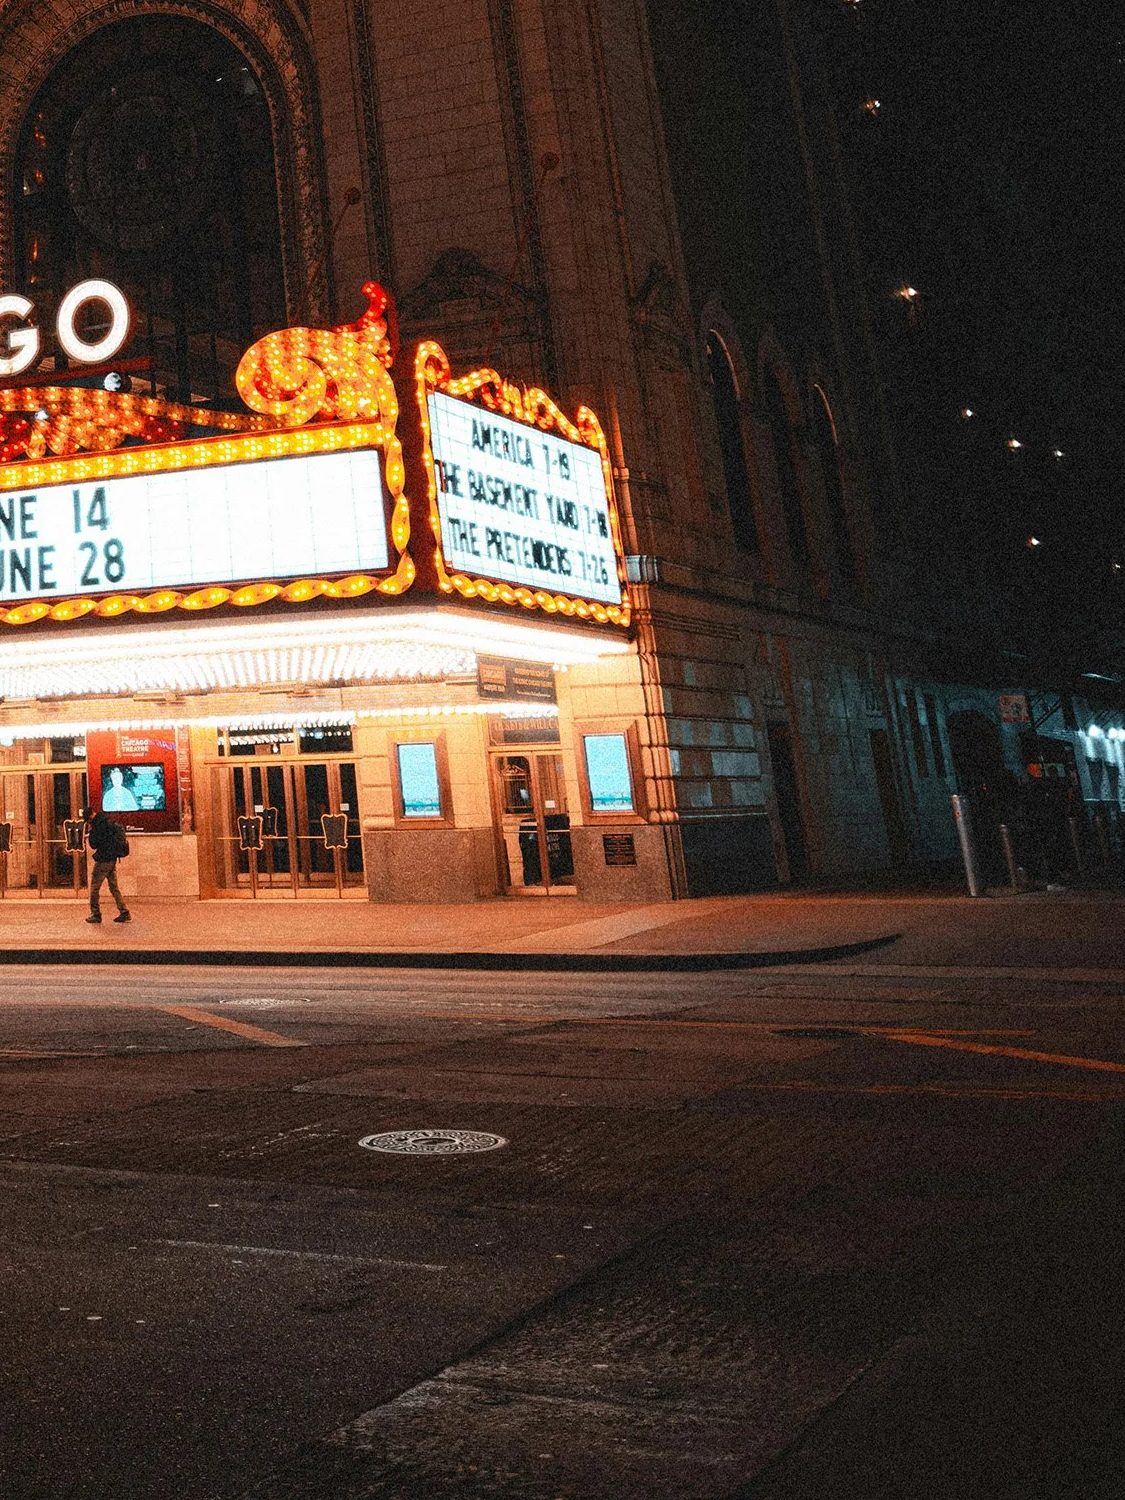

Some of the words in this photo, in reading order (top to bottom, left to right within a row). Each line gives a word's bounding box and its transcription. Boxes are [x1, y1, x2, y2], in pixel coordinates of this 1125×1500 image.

[471, 417, 536, 470] AMERICA
[73, 487, 110, 533] 14
[467, 468, 540, 520] BASEMENT
[544, 492, 580, 531] YARD
[79, 538, 127, 586] 28
[448, 517, 481, 557] THE
[485, 526, 572, 577] PRETENDERS
[578, 550, 609, 586] 7-26
